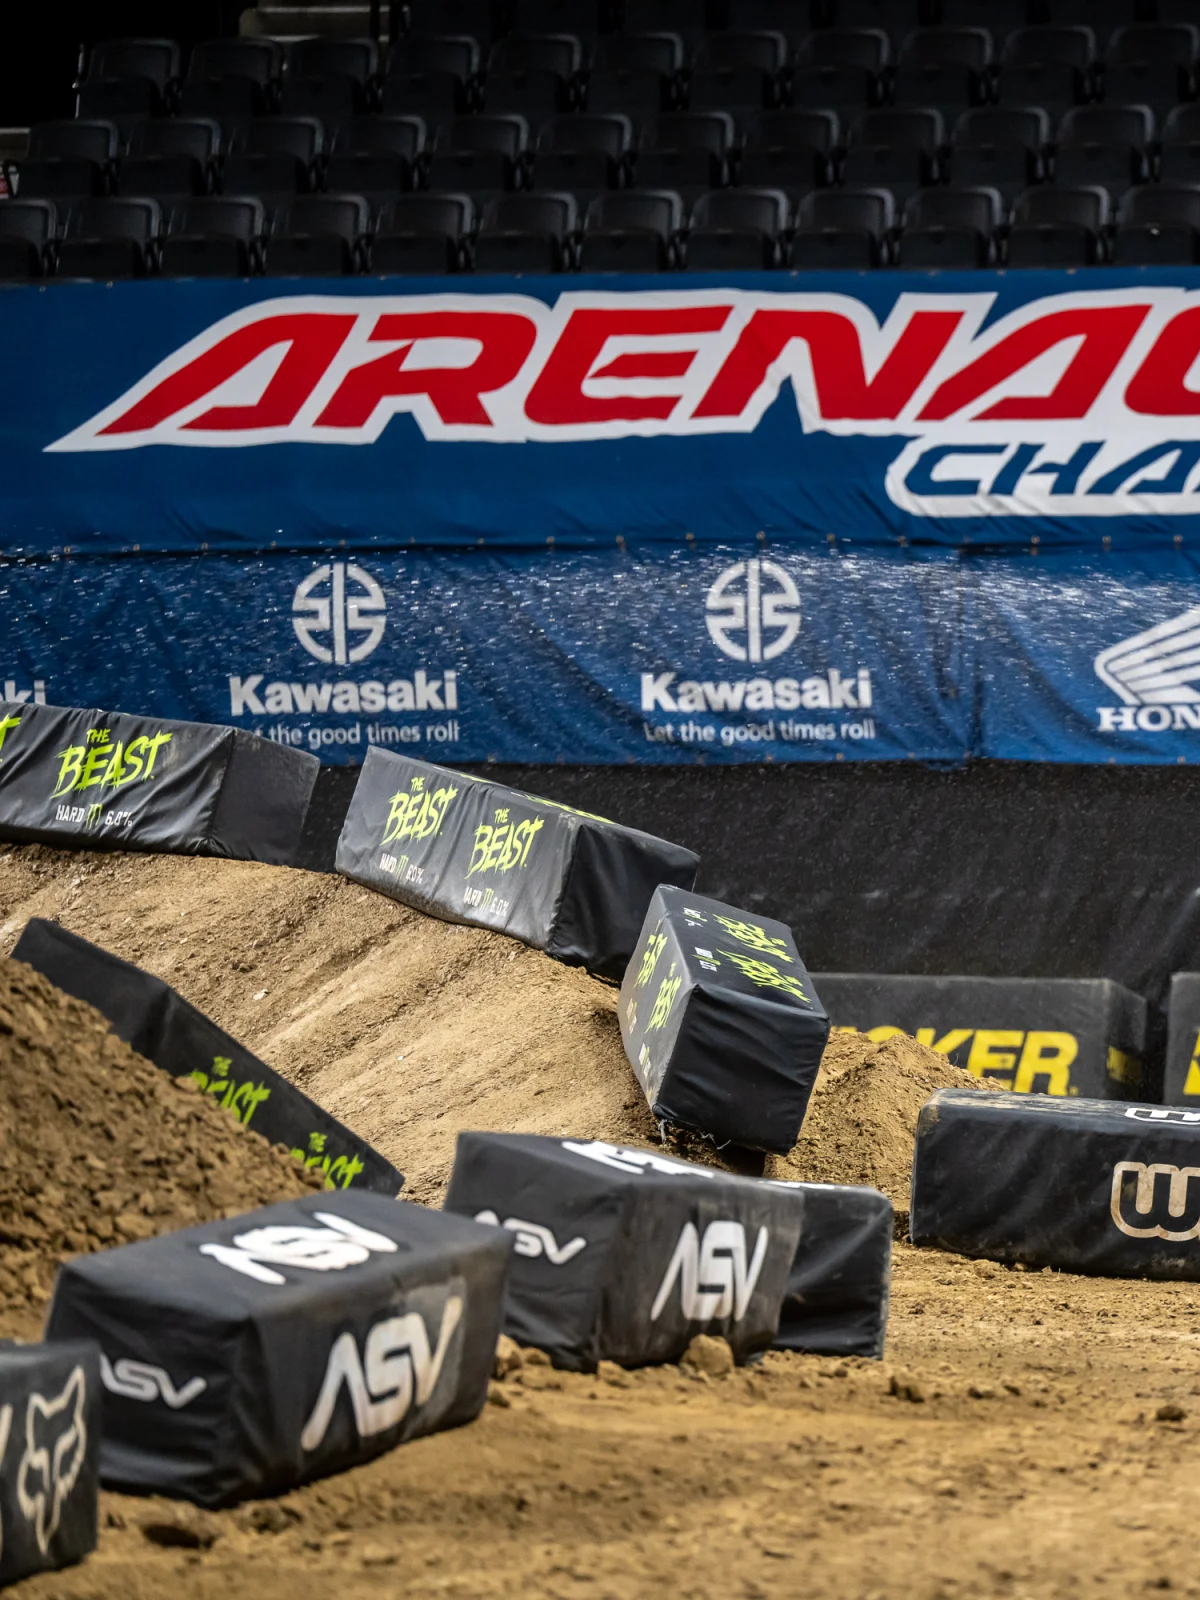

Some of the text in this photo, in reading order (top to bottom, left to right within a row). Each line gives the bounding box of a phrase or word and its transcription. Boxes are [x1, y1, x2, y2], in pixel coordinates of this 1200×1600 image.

[229, 670, 457, 716] Kawasaki
[640, 668, 872, 712] Kawasaki
[86, 728, 111, 743] THE
[308, 722, 360, 750] good
[366, 722, 421, 743] times
[426, 719, 459, 742] roll
[680, 719, 715, 742] the
[720, 718, 776, 747] good
[779, 717, 836, 741] times
[841, 717, 876, 740] roll
[50, 730, 173, 800] BEAST
[411, 776, 425, 791] THE
[56, 804, 85, 823] HARD
[380, 783, 458, 847] BEAST
[495, 808, 510, 824] THE
[464, 815, 544, 880] BEAST
